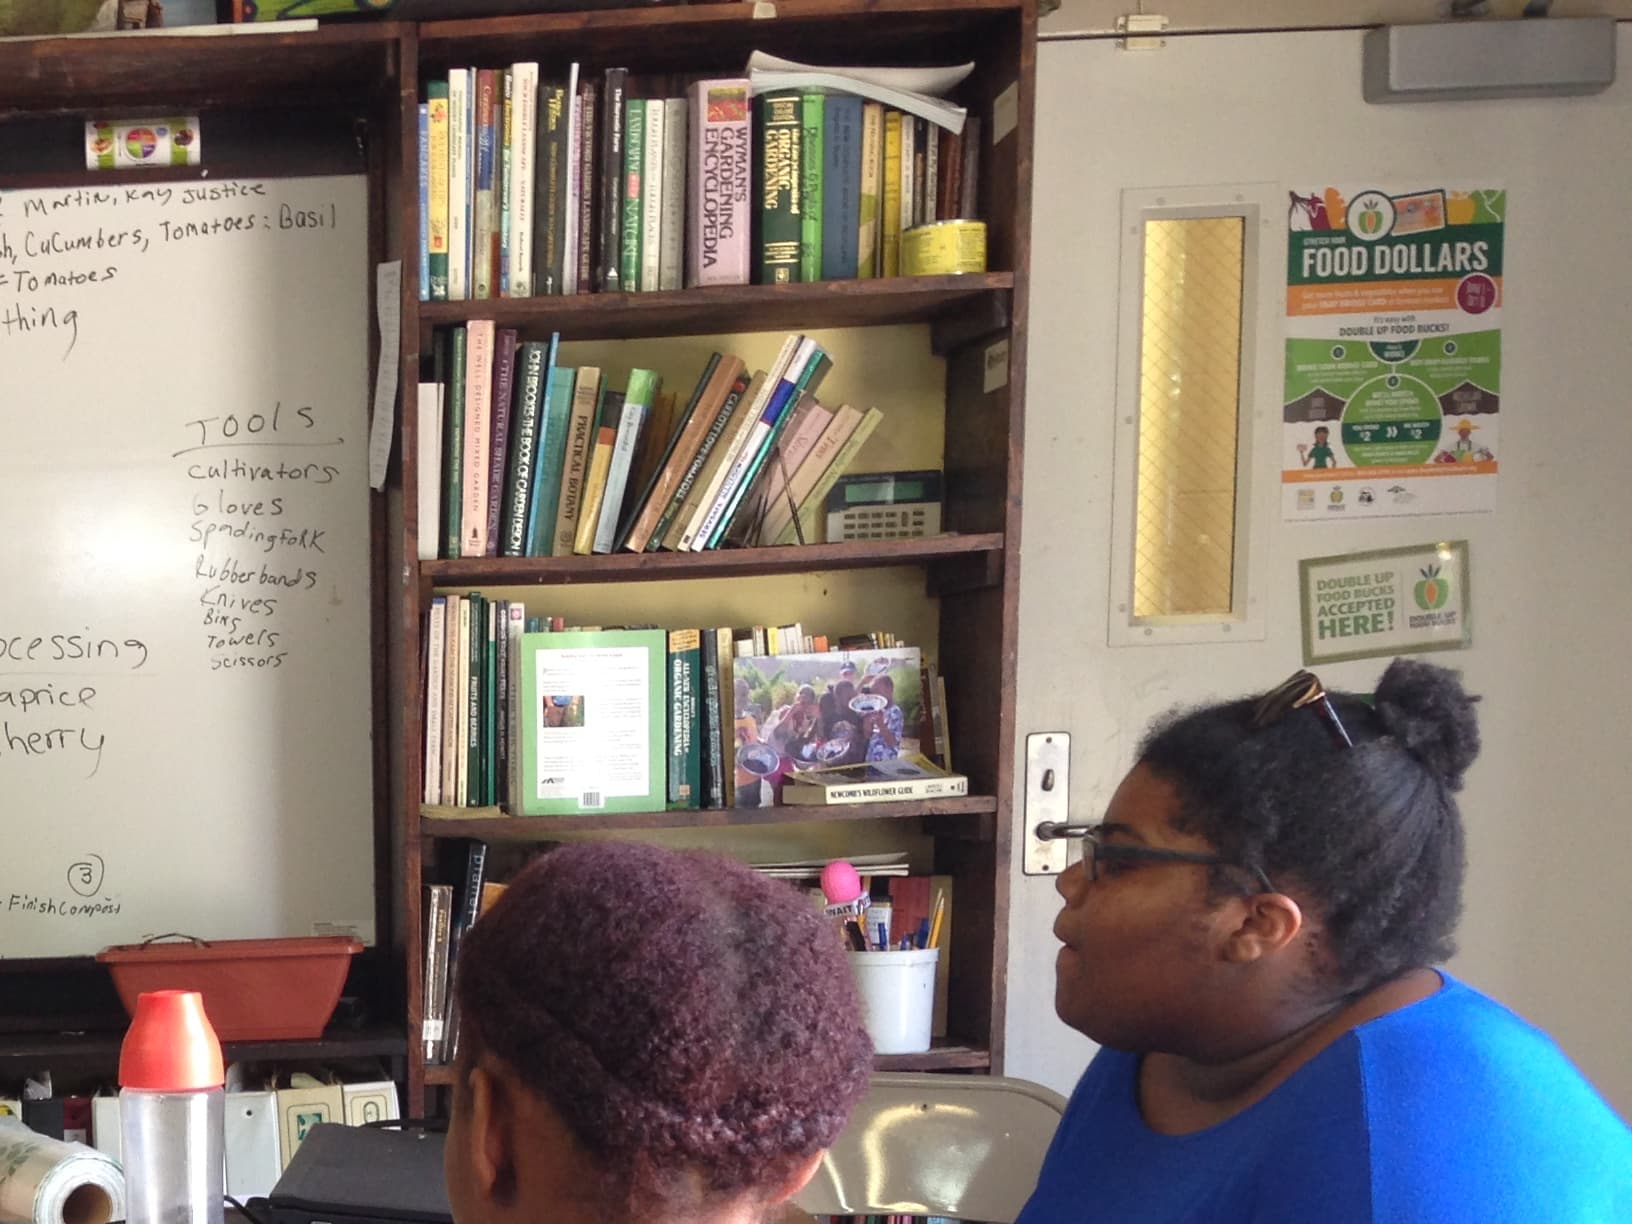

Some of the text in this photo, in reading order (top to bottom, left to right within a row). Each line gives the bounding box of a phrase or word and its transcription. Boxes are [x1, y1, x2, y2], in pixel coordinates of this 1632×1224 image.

[735, 127, 747, 202] WYMAN'S
[765, 129, 778, 209] GARDENING
[778, 129, 791, 190] ORGANIC
[703, 127, 719, 268] ENCYCLOPEDIA
[720, 127, 734, 239] GARDENING
[1302, 241, 1488, 277] FOOD DOLLARS
[1390, 324, 1415, 334] FOOD
[473, 385, 482, 433] DESIGNED
[473, 437, 481, 467] MIXED
[564, 415, 587, 521] PRACTICAL BOTANY
[472, 473, 481, 511] GARDEN
[1317, 571, 1394, 591] DOUBLE UP
[1317, 591, 1351, 603] FOOD
[1317, 598, 1395, 617] ACCEPTED
[1319, 611, 1394, 640] HERE!
[673, 659, 682, 757] ORGANIC GARDENING
